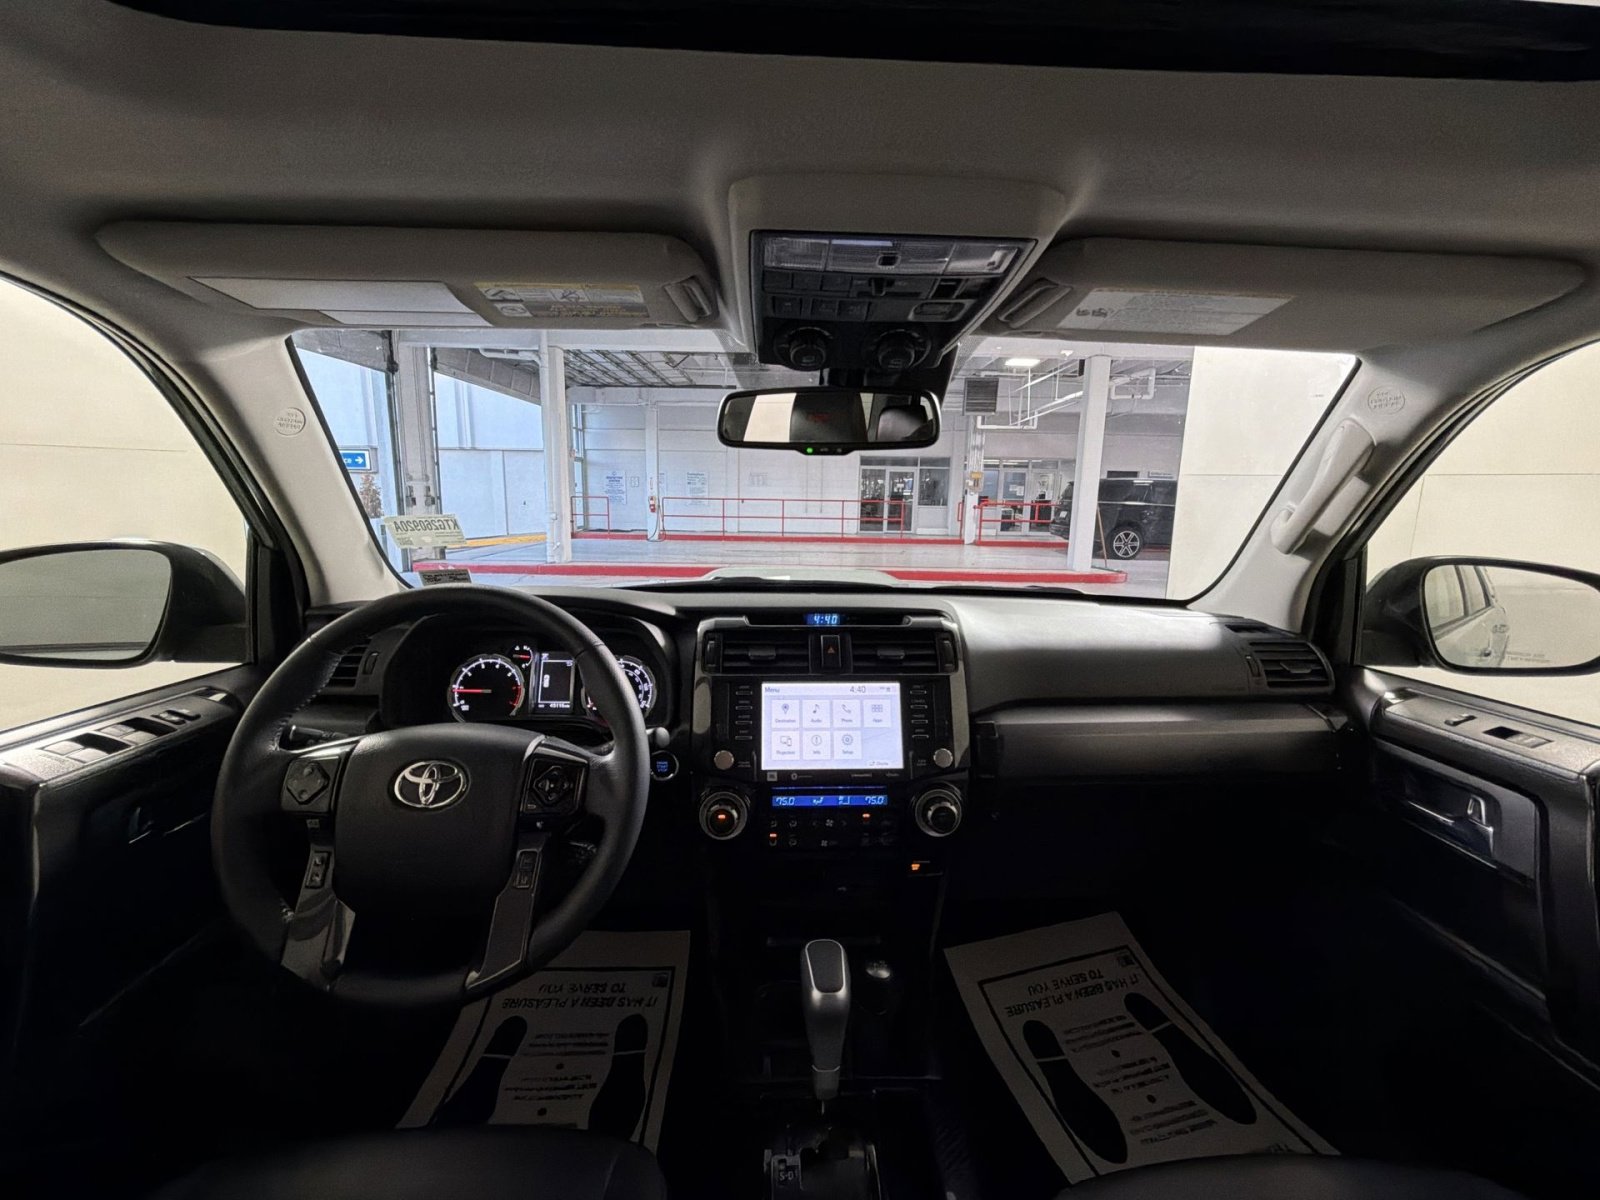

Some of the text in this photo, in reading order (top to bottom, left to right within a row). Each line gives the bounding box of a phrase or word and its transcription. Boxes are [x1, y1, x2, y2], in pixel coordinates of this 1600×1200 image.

[813, 614, 839, 625] 4:40
[849, 685, 867, 694] 4:40
[1088, 969, 1104, 979] TO
[611, 983, 626, 993] TO
[502, 998, 569, 1009] PLEASURE
[570, 997, 580, 1008] A
[1004, 994, 1064, 1017] PLEASURE
